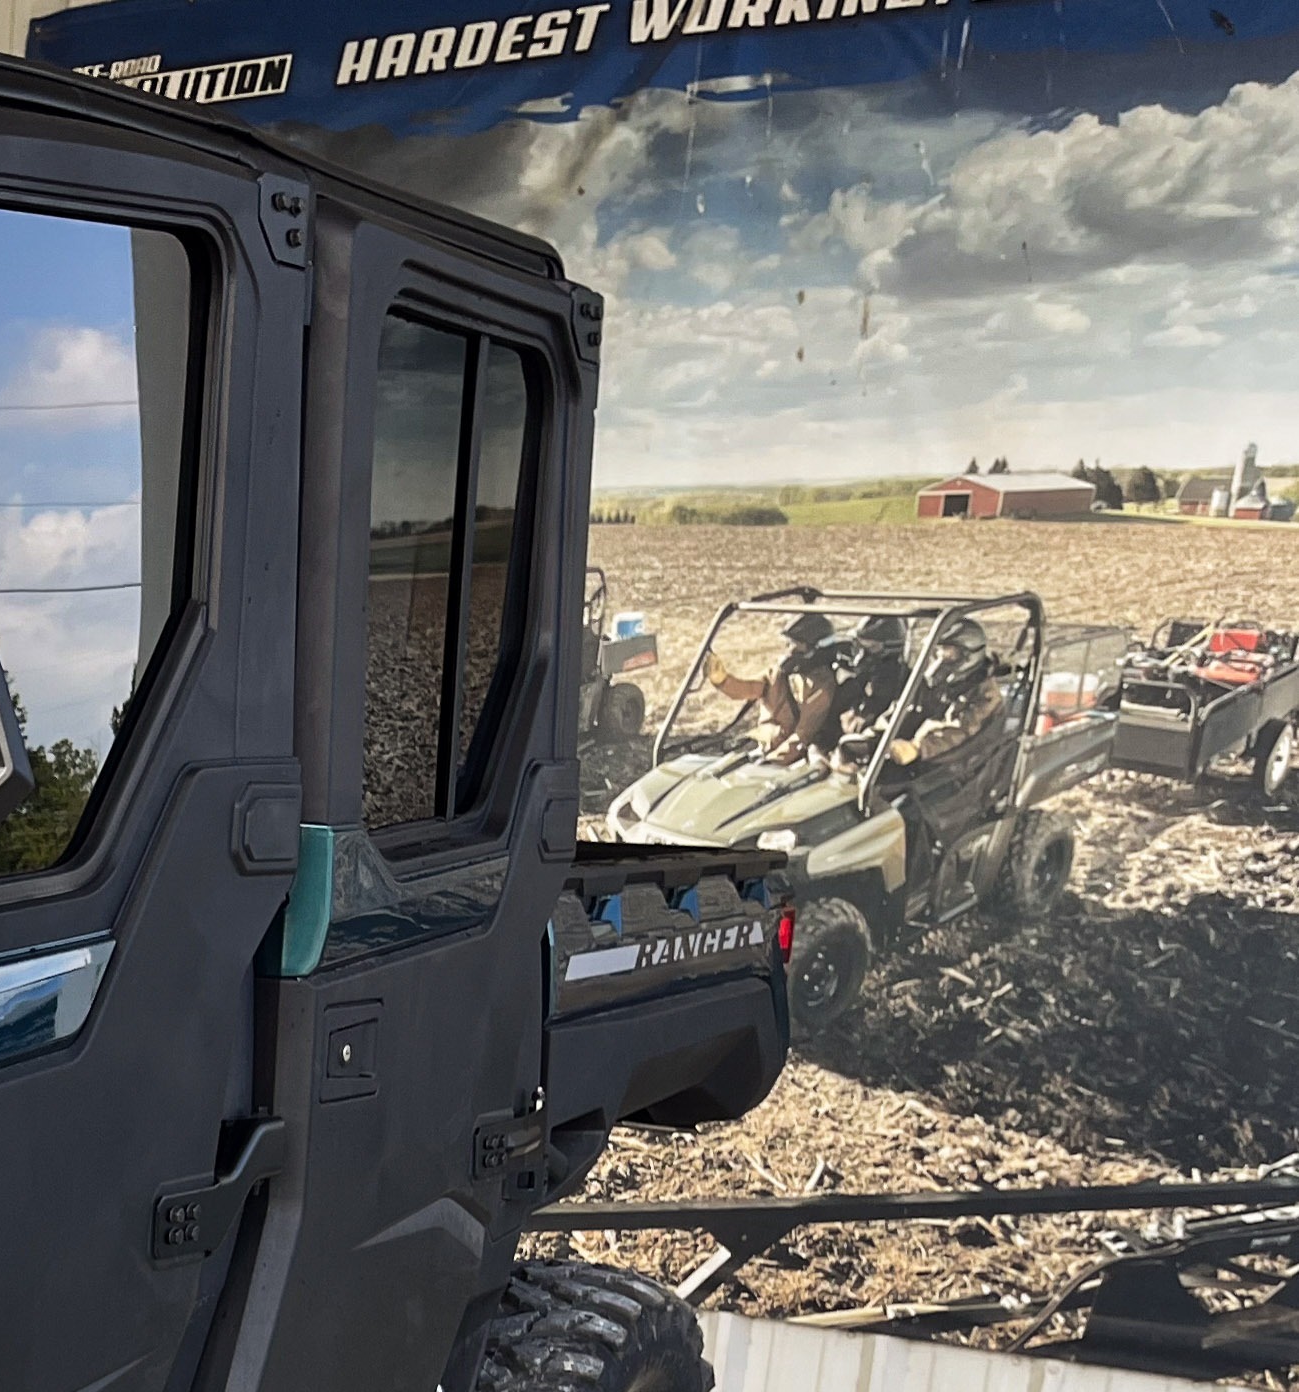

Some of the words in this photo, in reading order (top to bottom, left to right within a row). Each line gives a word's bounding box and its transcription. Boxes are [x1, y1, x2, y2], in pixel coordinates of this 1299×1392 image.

[336, 4, 610, 85] HARDEST
[629, 0, 924, 44] WORK
[136, 55, 291, 102] LUTION
[640, 921, 757, 969] RANGER
